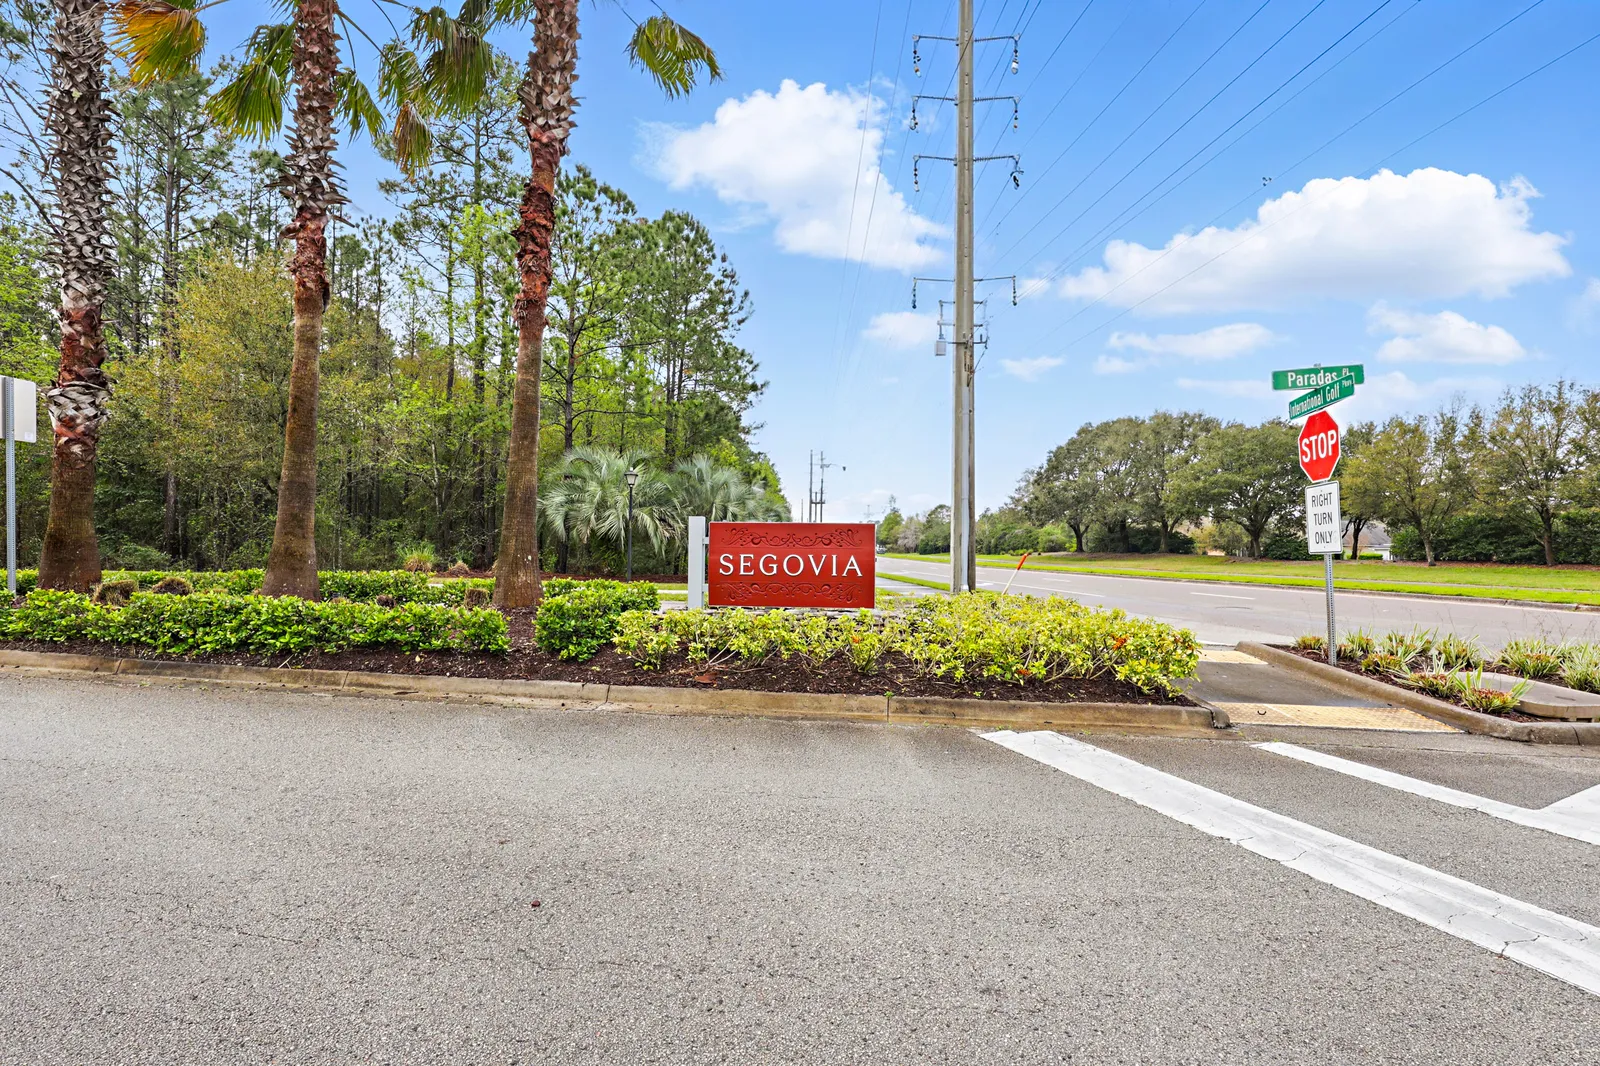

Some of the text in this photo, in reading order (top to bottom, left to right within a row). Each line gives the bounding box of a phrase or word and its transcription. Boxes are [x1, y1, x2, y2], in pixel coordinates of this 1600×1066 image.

[1287, 369, 1338, 387] Paradas
[1289, 379, 1352, 418] International Golf Pkwy
[1301, 429, 1337, 463] STOP
[1311, 492, 1332, 508] RIGHT
[1313, 511, 1333, 526] TURN
[1314, 530, 1333, 545] ONLY
[719, 553, 863, 577] SEGOVIA
